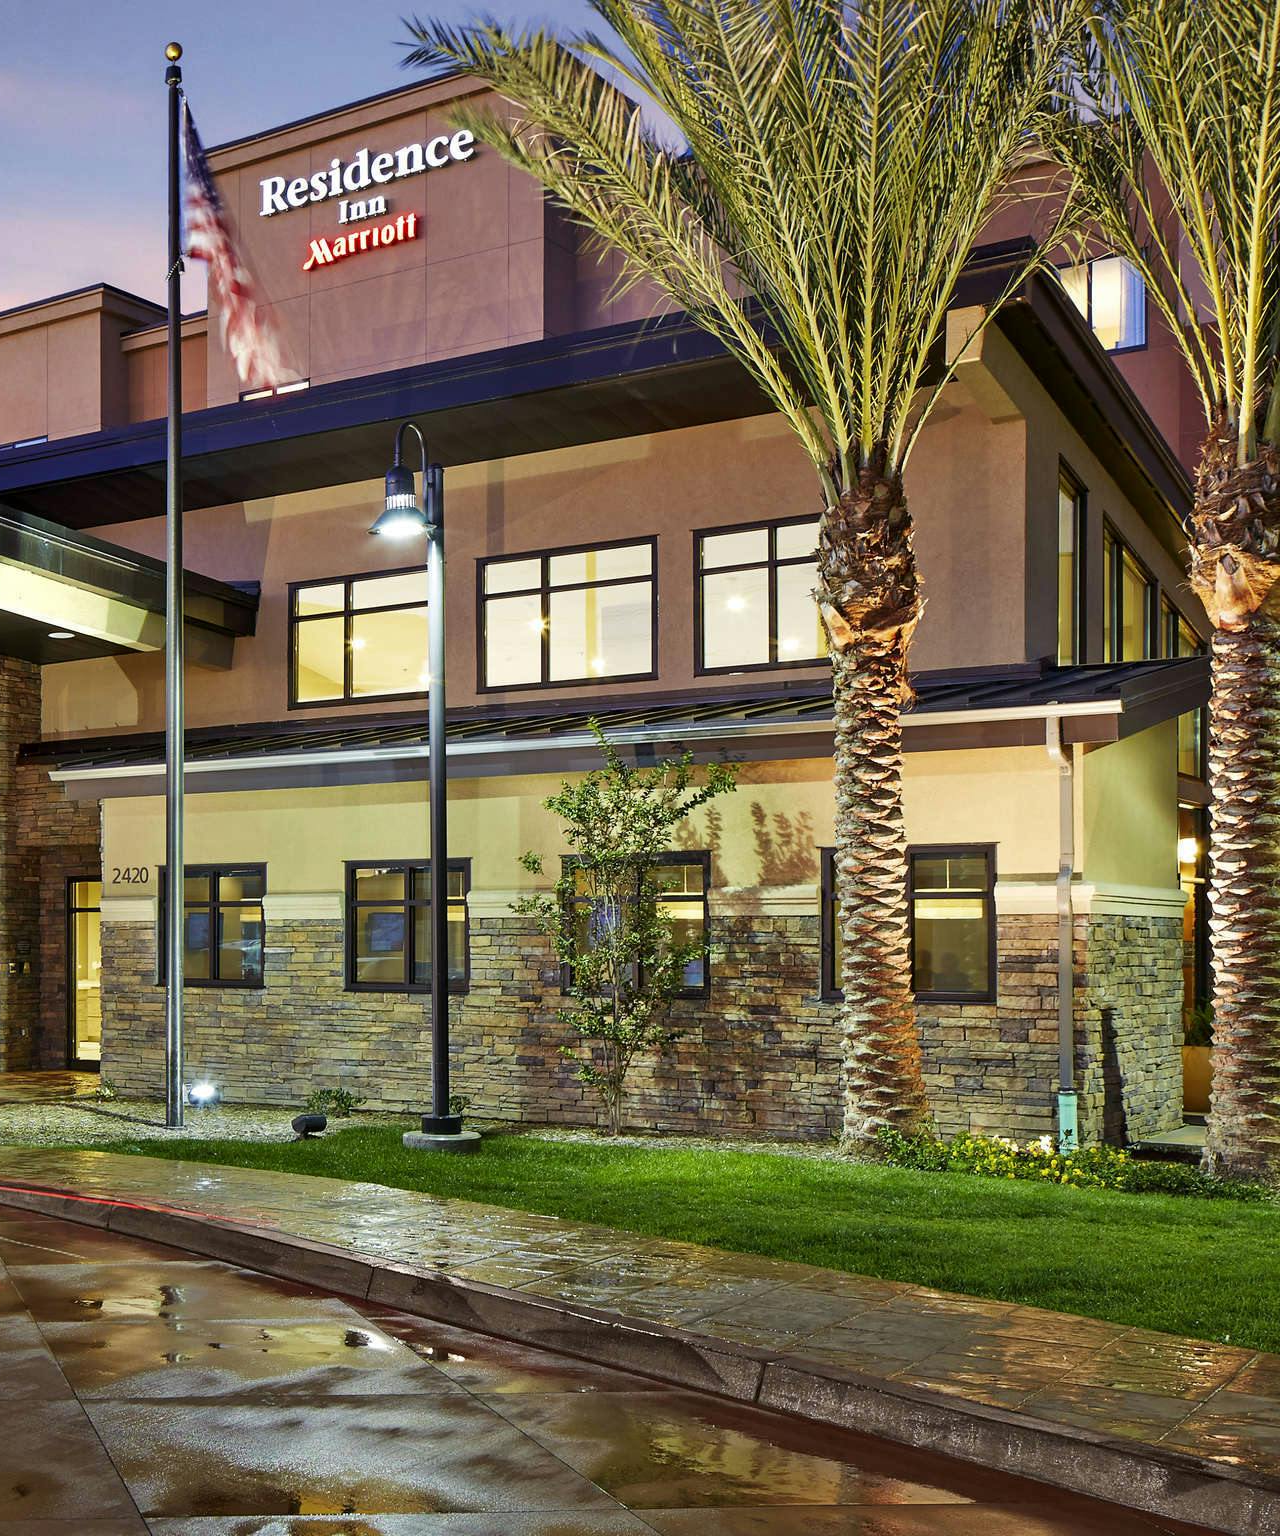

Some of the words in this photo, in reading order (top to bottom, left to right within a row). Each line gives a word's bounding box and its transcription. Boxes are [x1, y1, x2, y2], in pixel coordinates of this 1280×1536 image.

[259, 129, 475, 217] Residence
[338, 195, 387, 224] Inn
[302, 212, 417, 271] Marriott
[112, 867, 149, 884] 2420
